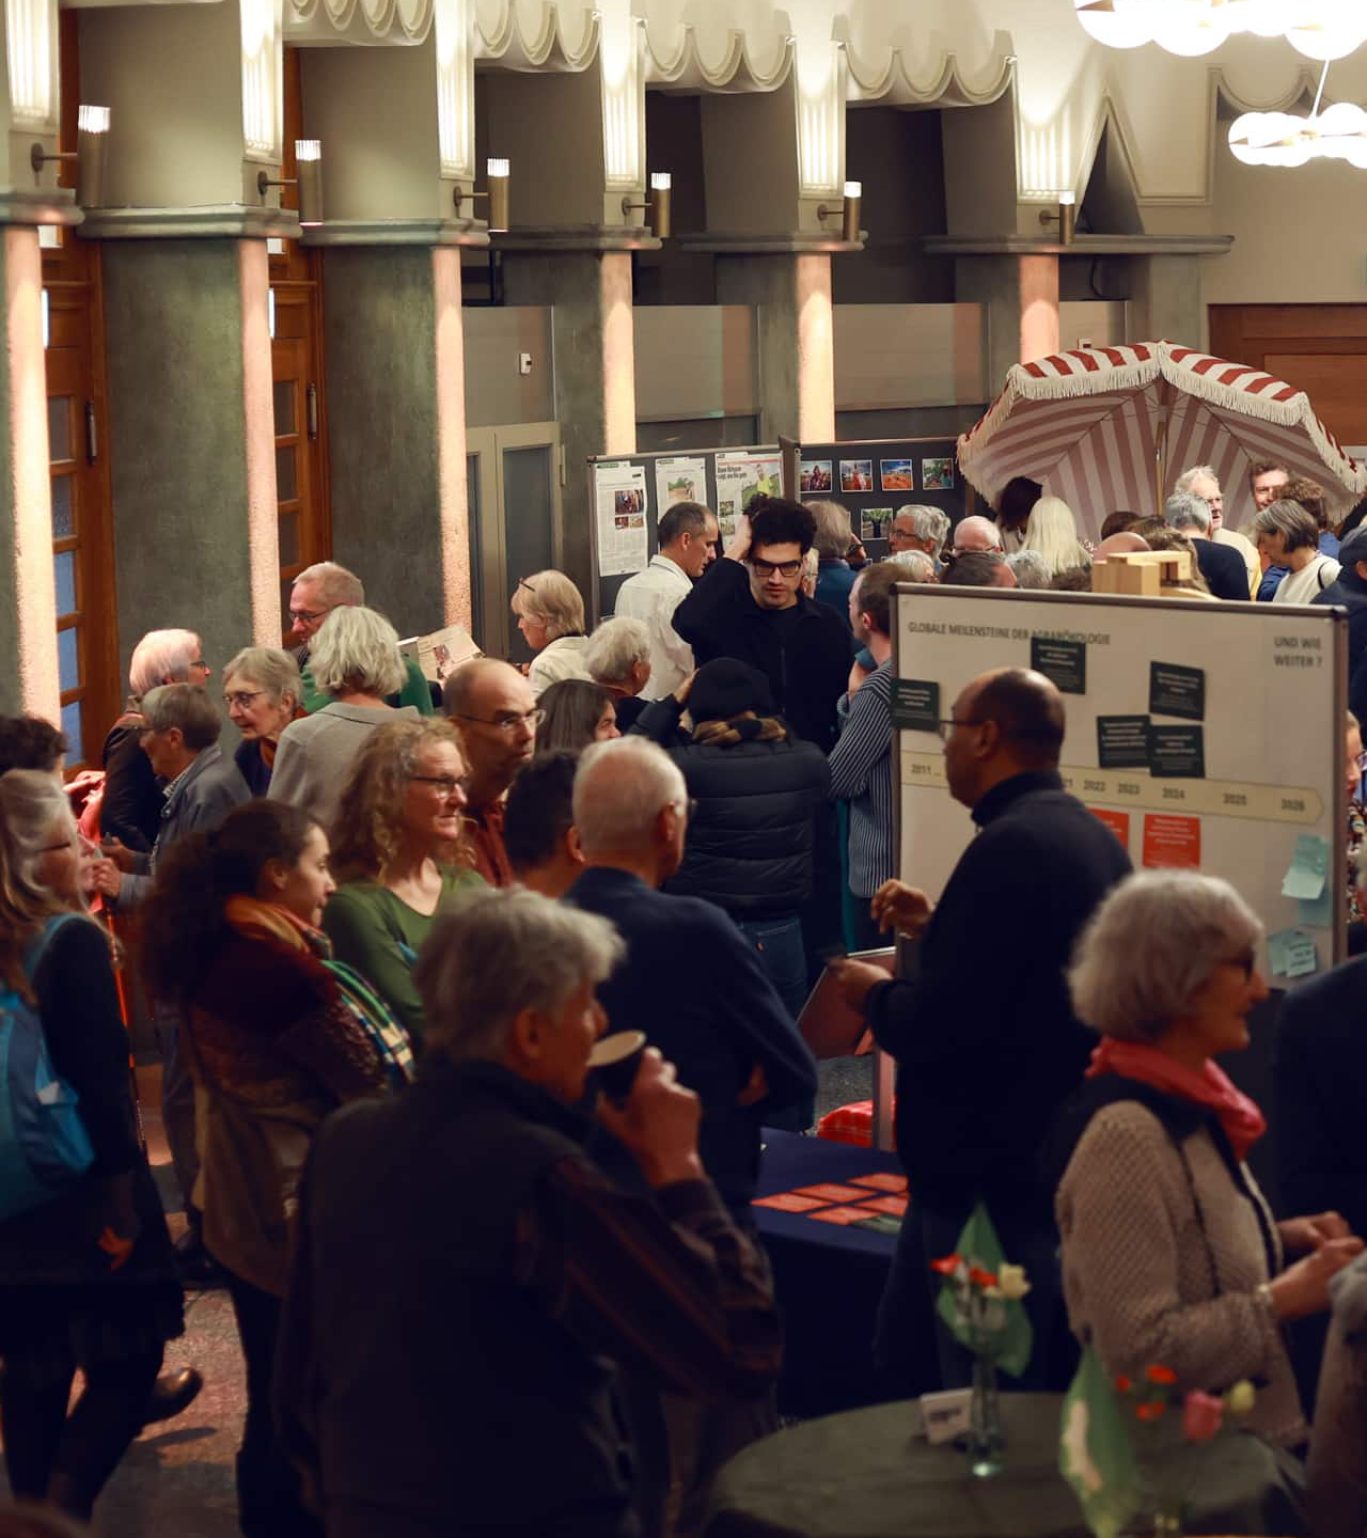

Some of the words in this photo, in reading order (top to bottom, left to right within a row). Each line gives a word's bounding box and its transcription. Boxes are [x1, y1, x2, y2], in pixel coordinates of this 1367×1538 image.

[909, 622, 946, 635] GLOBALE
[949, 625, 1009, 639] MEILENSTEINE
[1012, 629, 1029, 641] DER
[1274, 637, 1298, 648] UND
[1302, 638, 1321, 649] WIE
[1274, 656, 1314, 667] WEITER
[1084, 779, 1106, 792] 2022
[1118, 784, 1140, 795] 2023
[1162, 787, 1185, 799] 2024
[1223, 793, 1247, 805] 2025
